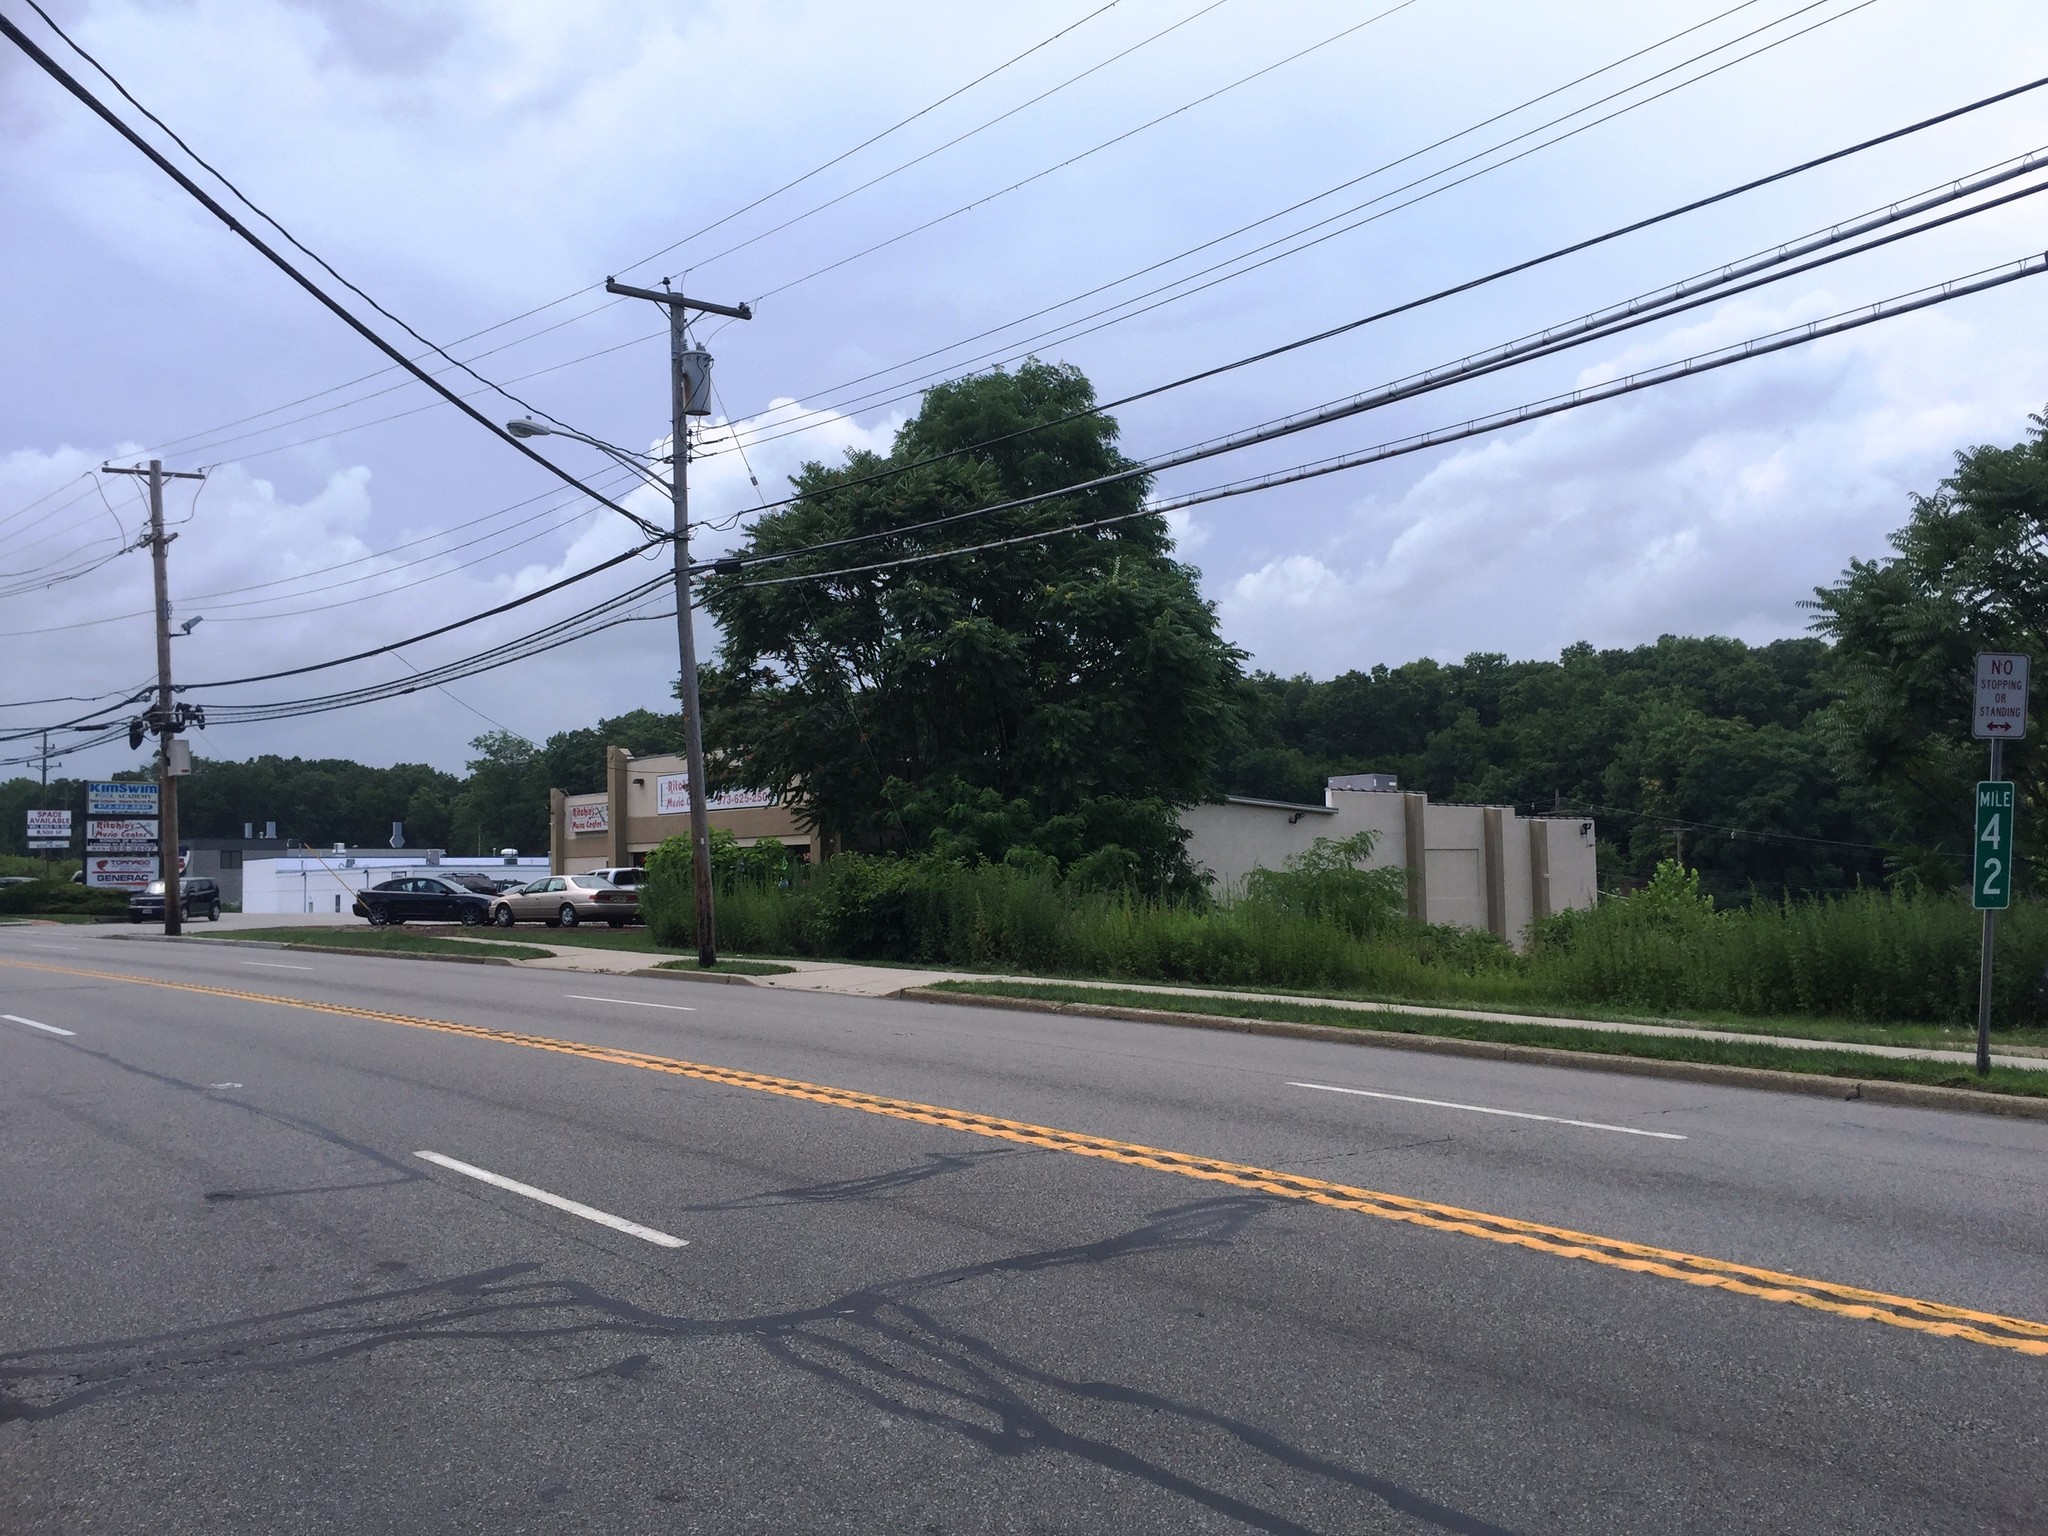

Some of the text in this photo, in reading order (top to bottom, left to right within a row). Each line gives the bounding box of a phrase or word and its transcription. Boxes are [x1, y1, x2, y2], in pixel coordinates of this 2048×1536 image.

[1991, 659, 2013, 675] NO
[1981, 679, 2022, 691] STOPPING
[1995, 693, 2006, 704] OR
[1979, 706, 2021, 718] STANDING
[89, 783, 158, 794] KimSwim
[1980, 791, 2011, 807] MILE
[96, 821, 135, 830] Ritchie's
[1981, 813, 2001, 850] 4
[121, 830, 147, 838] Center
[96, 874, 149, 882] GENERAC
[1983, 857, 2002, 895] 2
